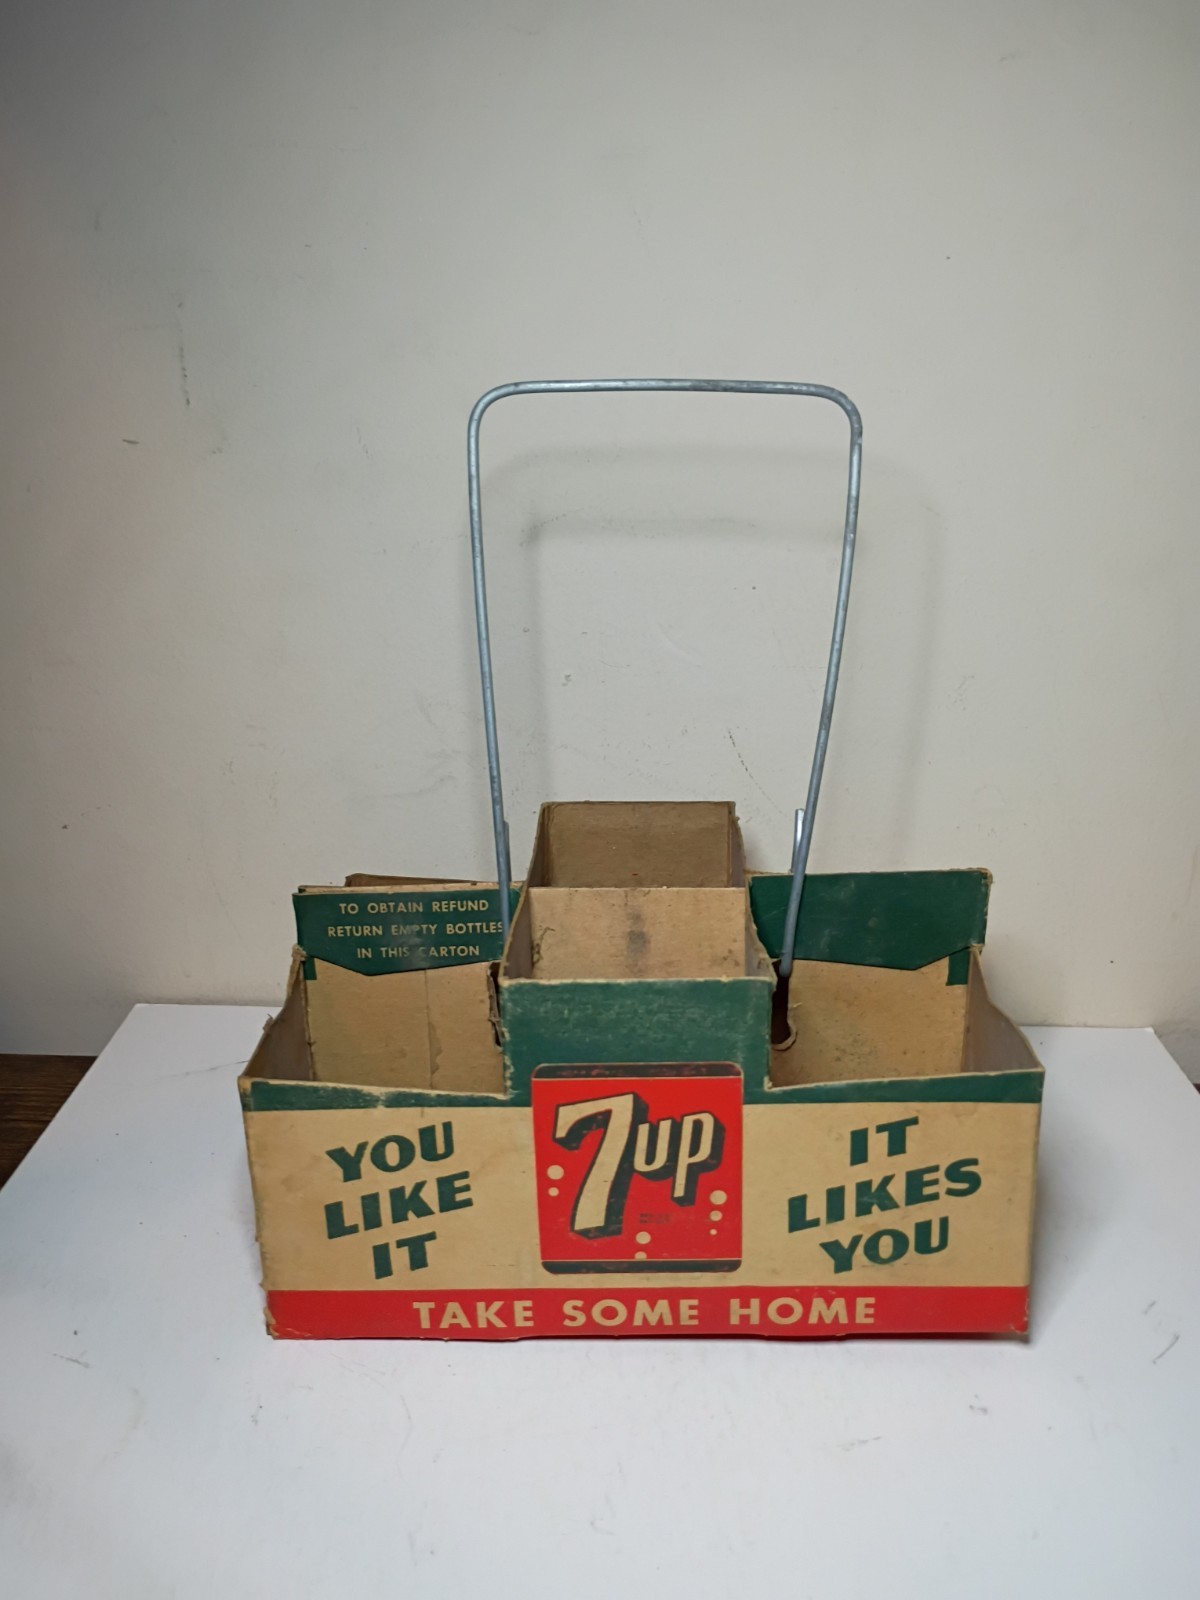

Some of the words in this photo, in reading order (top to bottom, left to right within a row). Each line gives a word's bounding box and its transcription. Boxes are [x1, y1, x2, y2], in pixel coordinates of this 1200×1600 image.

[327, 925, 383, 937] RETURN
[391, 923, 437, 935] EMPTY
[446, 921, 503, 934] BOTTLES
[339, 902, 359, 915] TO
[367, 902, 424, 914] OBTAIN
[432, 899, 489, 912] REFUND
[357, 947, 372, 958] IN
[380, 946, 410, 958] THIS
[418, 945, 480, 958] CARTON
[325, 1121, 454, 1182] YOU
[850, 1116, 919, 1167] IT
[324, 1170, 474, 1239] LIKE
[788, 1158, 982, 1233] LIKES
[372, 1231, 437, 1280] IT
[819, 1216, 949, 1274] YOU
[412, 1300, 535, 1329] TAKE
[562, 1299, 699, 1327] SOME
[729, 1297, 876, 1325] HOME
